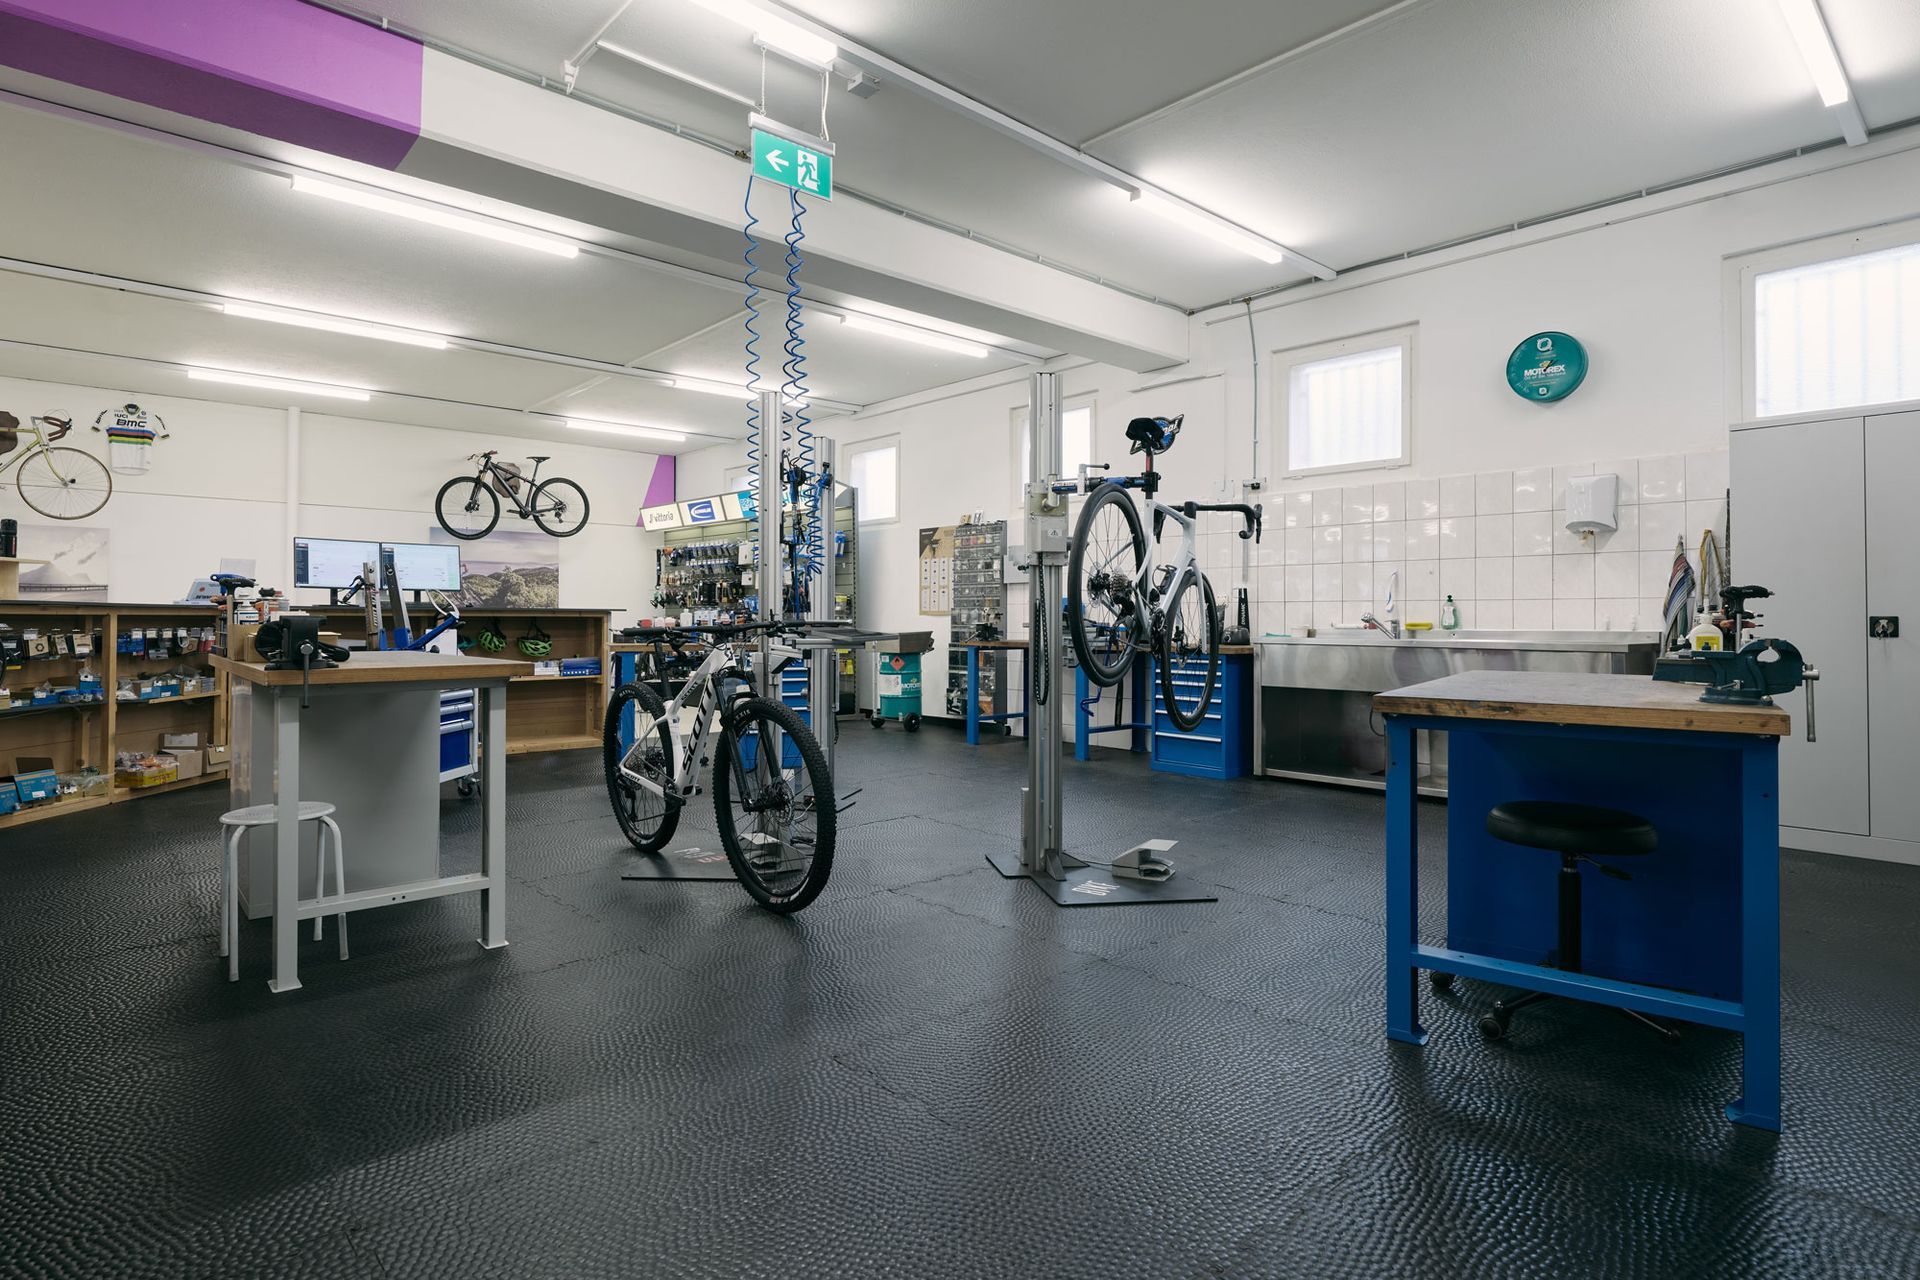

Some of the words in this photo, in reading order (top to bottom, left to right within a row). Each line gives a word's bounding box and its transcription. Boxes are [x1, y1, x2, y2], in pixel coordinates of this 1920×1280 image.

[116, 418, 147, 428] BMC
[654, 511, 674, 523] vittoria
[681, 682, 699, 701] SCOTT
[683, 676, 713, 775] SCOTT
[624, 772, 640, 782] SCOTT
